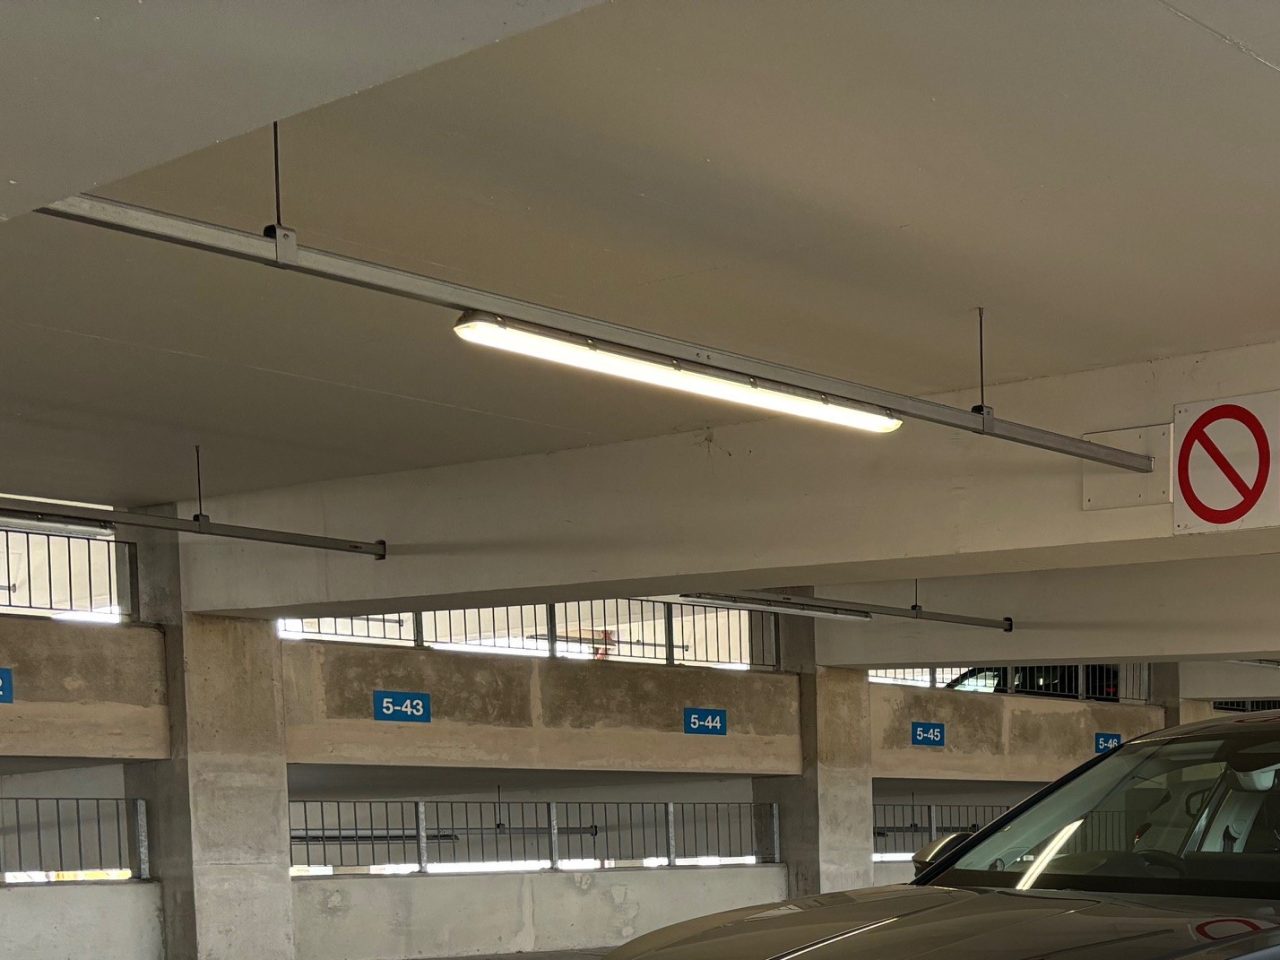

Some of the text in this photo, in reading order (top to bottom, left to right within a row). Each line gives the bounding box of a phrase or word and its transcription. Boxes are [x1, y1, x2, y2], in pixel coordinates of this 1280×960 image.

[382, 697, 424, 716] 5-43
[690, 714, 722, 730] 5-44
[916, 727, 941, 741] 5-45
